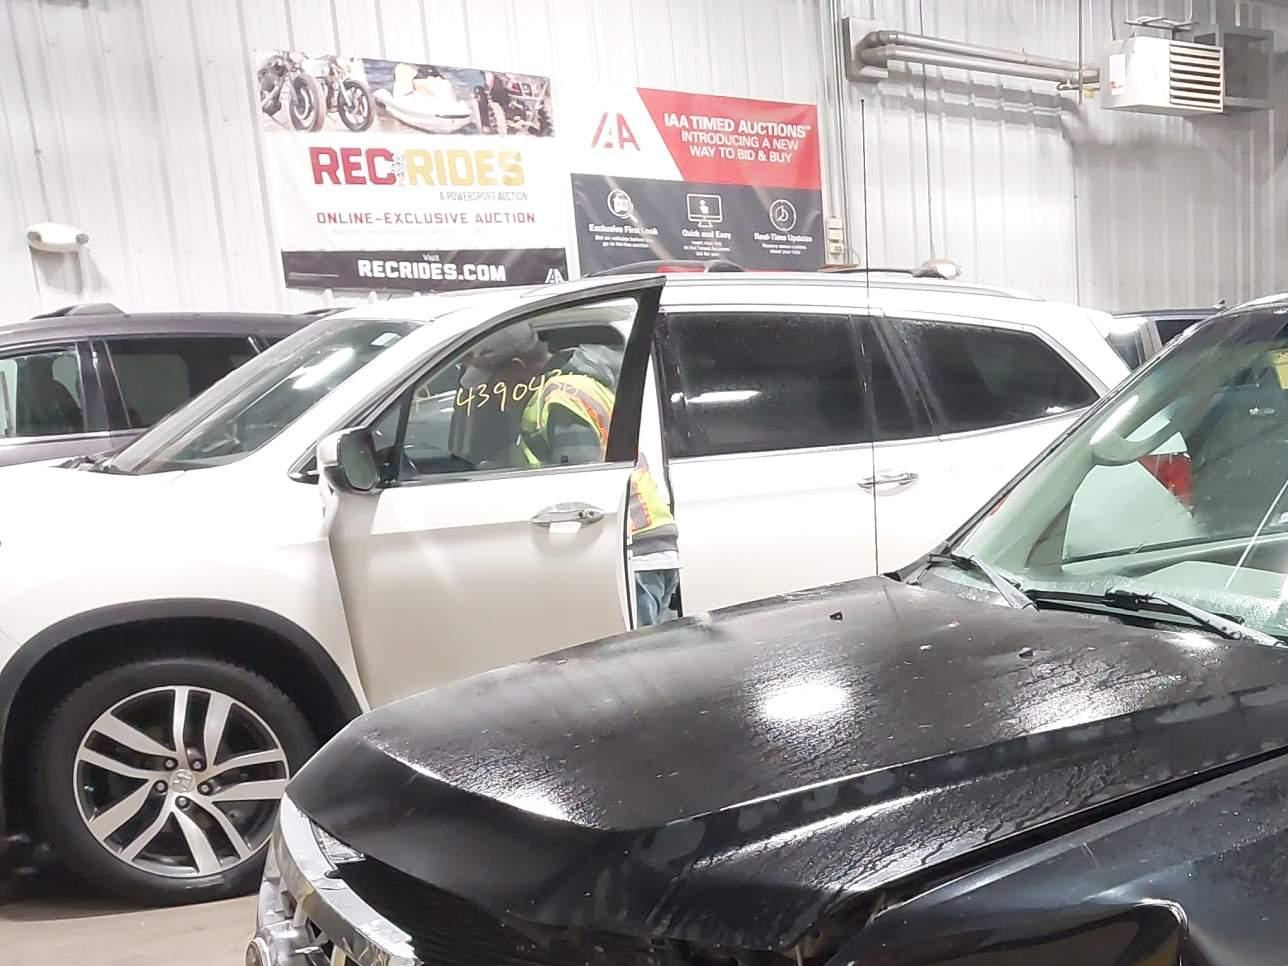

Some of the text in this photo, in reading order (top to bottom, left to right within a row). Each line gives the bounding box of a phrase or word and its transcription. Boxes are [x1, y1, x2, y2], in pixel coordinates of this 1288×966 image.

[663, 112, 689, 129] IAA
[690, 115, 735, 132] TIMED
[681, 131, 799, 151] INTRODUCING A NEW
[689, 145, 793, 164] WAY TO BID & BUY
[447, 191, 496, 201] POWERSPORT
[498, 192, 528, 201] AUCTION
[316, 212, 535, 225] ONLINE-EXCLUSIVE AUCTION
[357, 259, 506, 282] RECRIDES.COM
